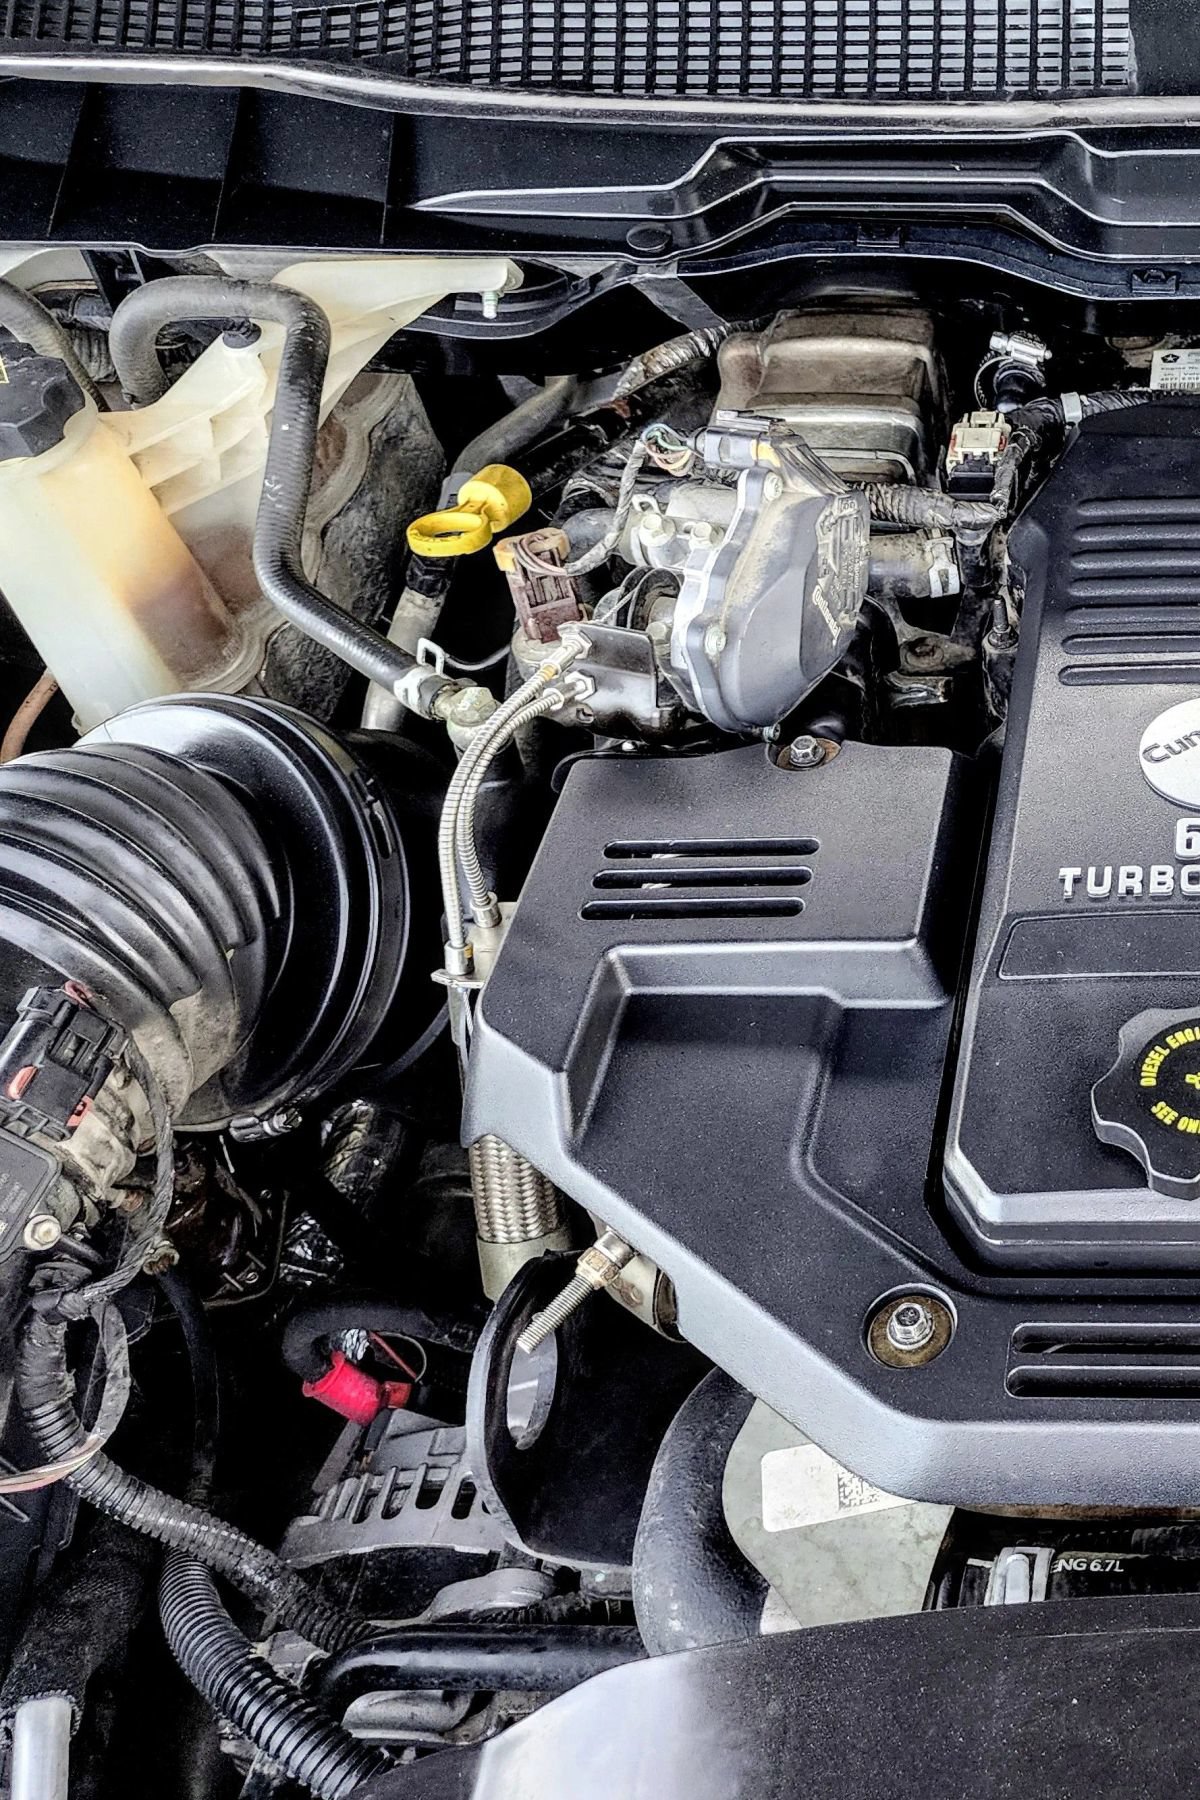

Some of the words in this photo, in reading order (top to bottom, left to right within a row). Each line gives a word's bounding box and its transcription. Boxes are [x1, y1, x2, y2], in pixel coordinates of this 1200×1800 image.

[1140, 1045, 1170, 1086] DIESEL
[1151, 1101, 1179, 1125] SEE
[1089, 1559, 1125, 1573] 6.7L
